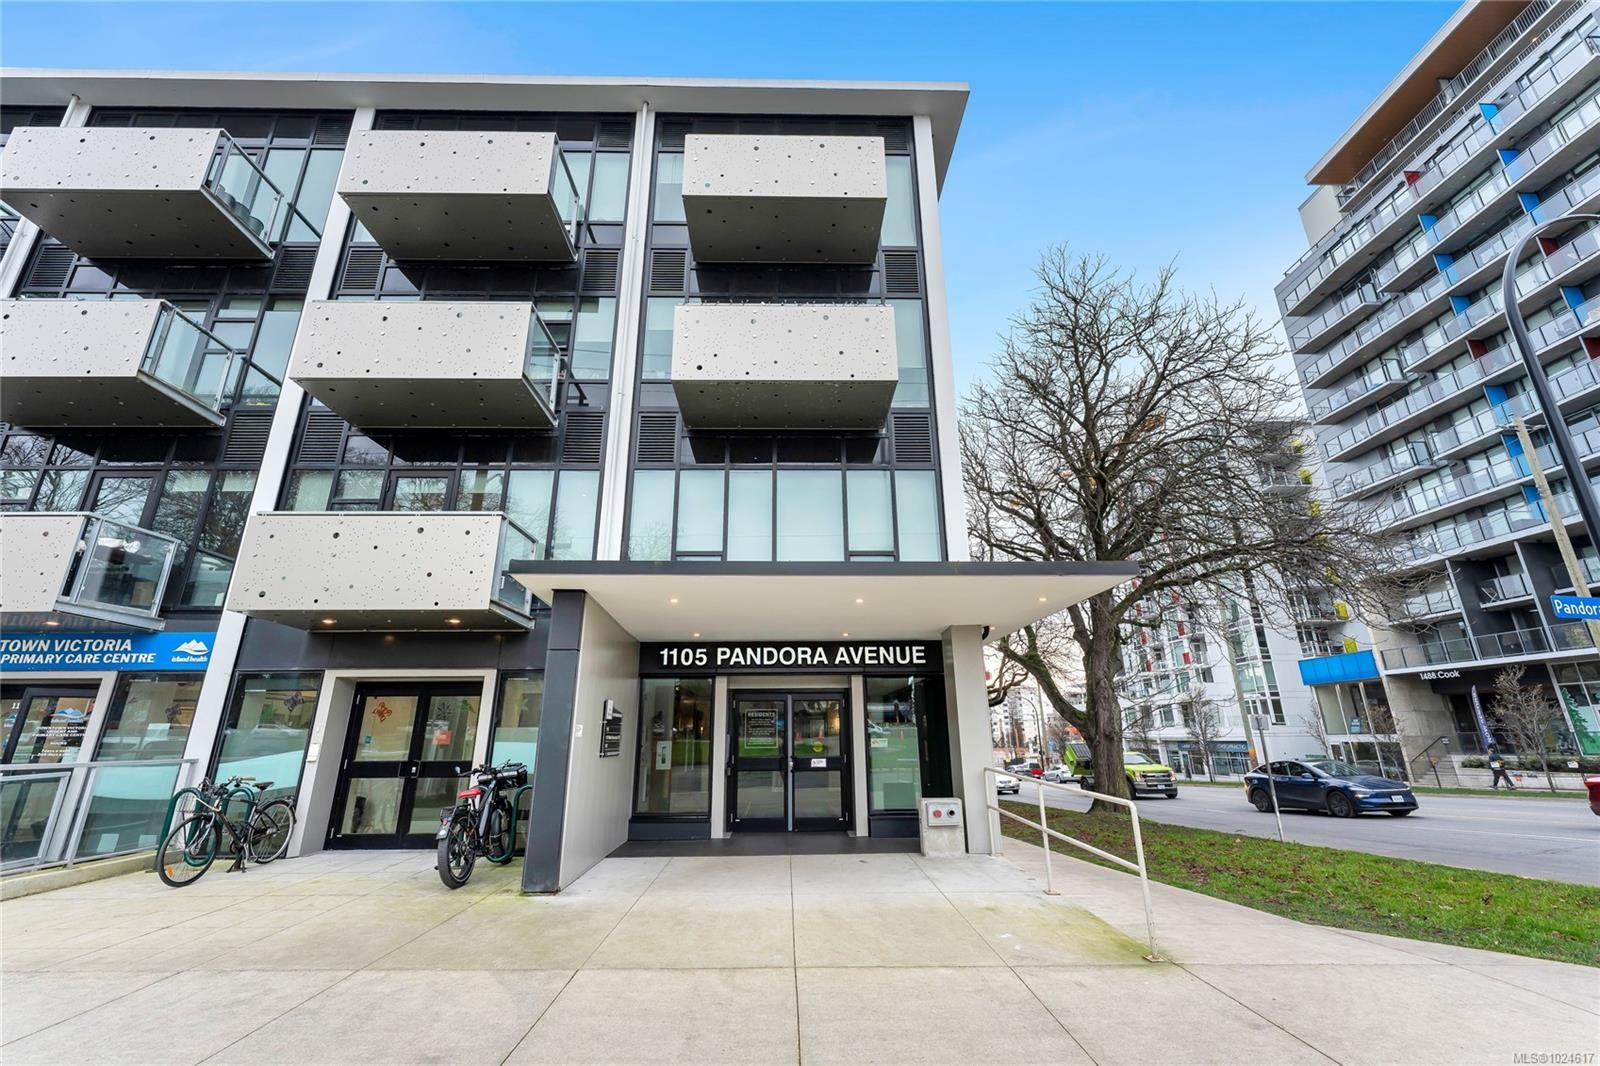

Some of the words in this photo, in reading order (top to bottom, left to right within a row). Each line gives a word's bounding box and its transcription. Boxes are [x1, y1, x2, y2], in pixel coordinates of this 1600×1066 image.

[1554, 600, 1600, 615] Pandor
[0, 639, 50, 652] TOWN
[54, 638, 132, 652] VICTORIA
[0, 653, 63, 664] PRIMARY
[65, 653, 101, 663] CARE
[103, 652, 157, 663] CENTRE
[659, 648, 708, 666] 1105
[717, 647, 829, 665] PANDORA
[834, 646, 927, 665] AVENUE
[1419, 672, 1437, 680] 1488
[1437, 670, 1460, 679] Cook
